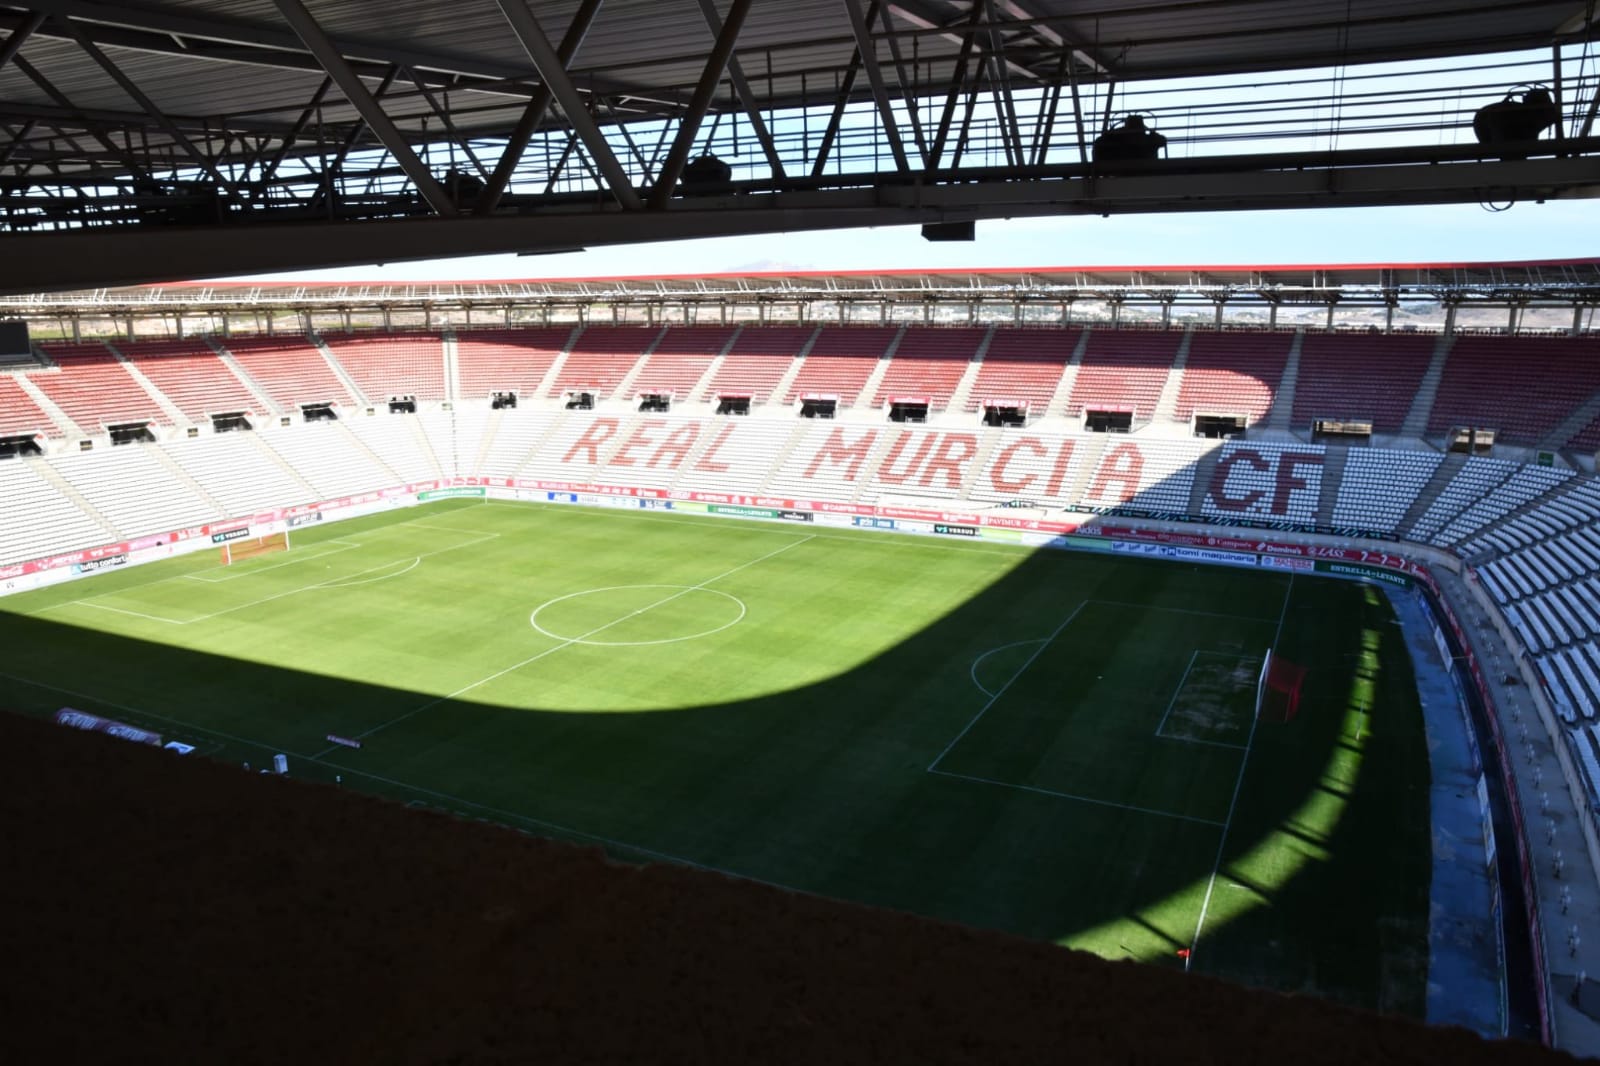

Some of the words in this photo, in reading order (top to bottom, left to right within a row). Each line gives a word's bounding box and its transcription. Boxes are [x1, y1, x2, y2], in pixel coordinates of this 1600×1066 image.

[561, 417, 737, 473] REAL
[802, 427, 1144, 503] MURCIA
[99, 554, 127, 568] confort
[1176, 548, 1200, 557] tomi
[1201, 551, 1256, 563] maquinaria
[1330, 564, 1372, 576] ESTRELLA
[1376, 571, 1406, 585] LEVANTE
